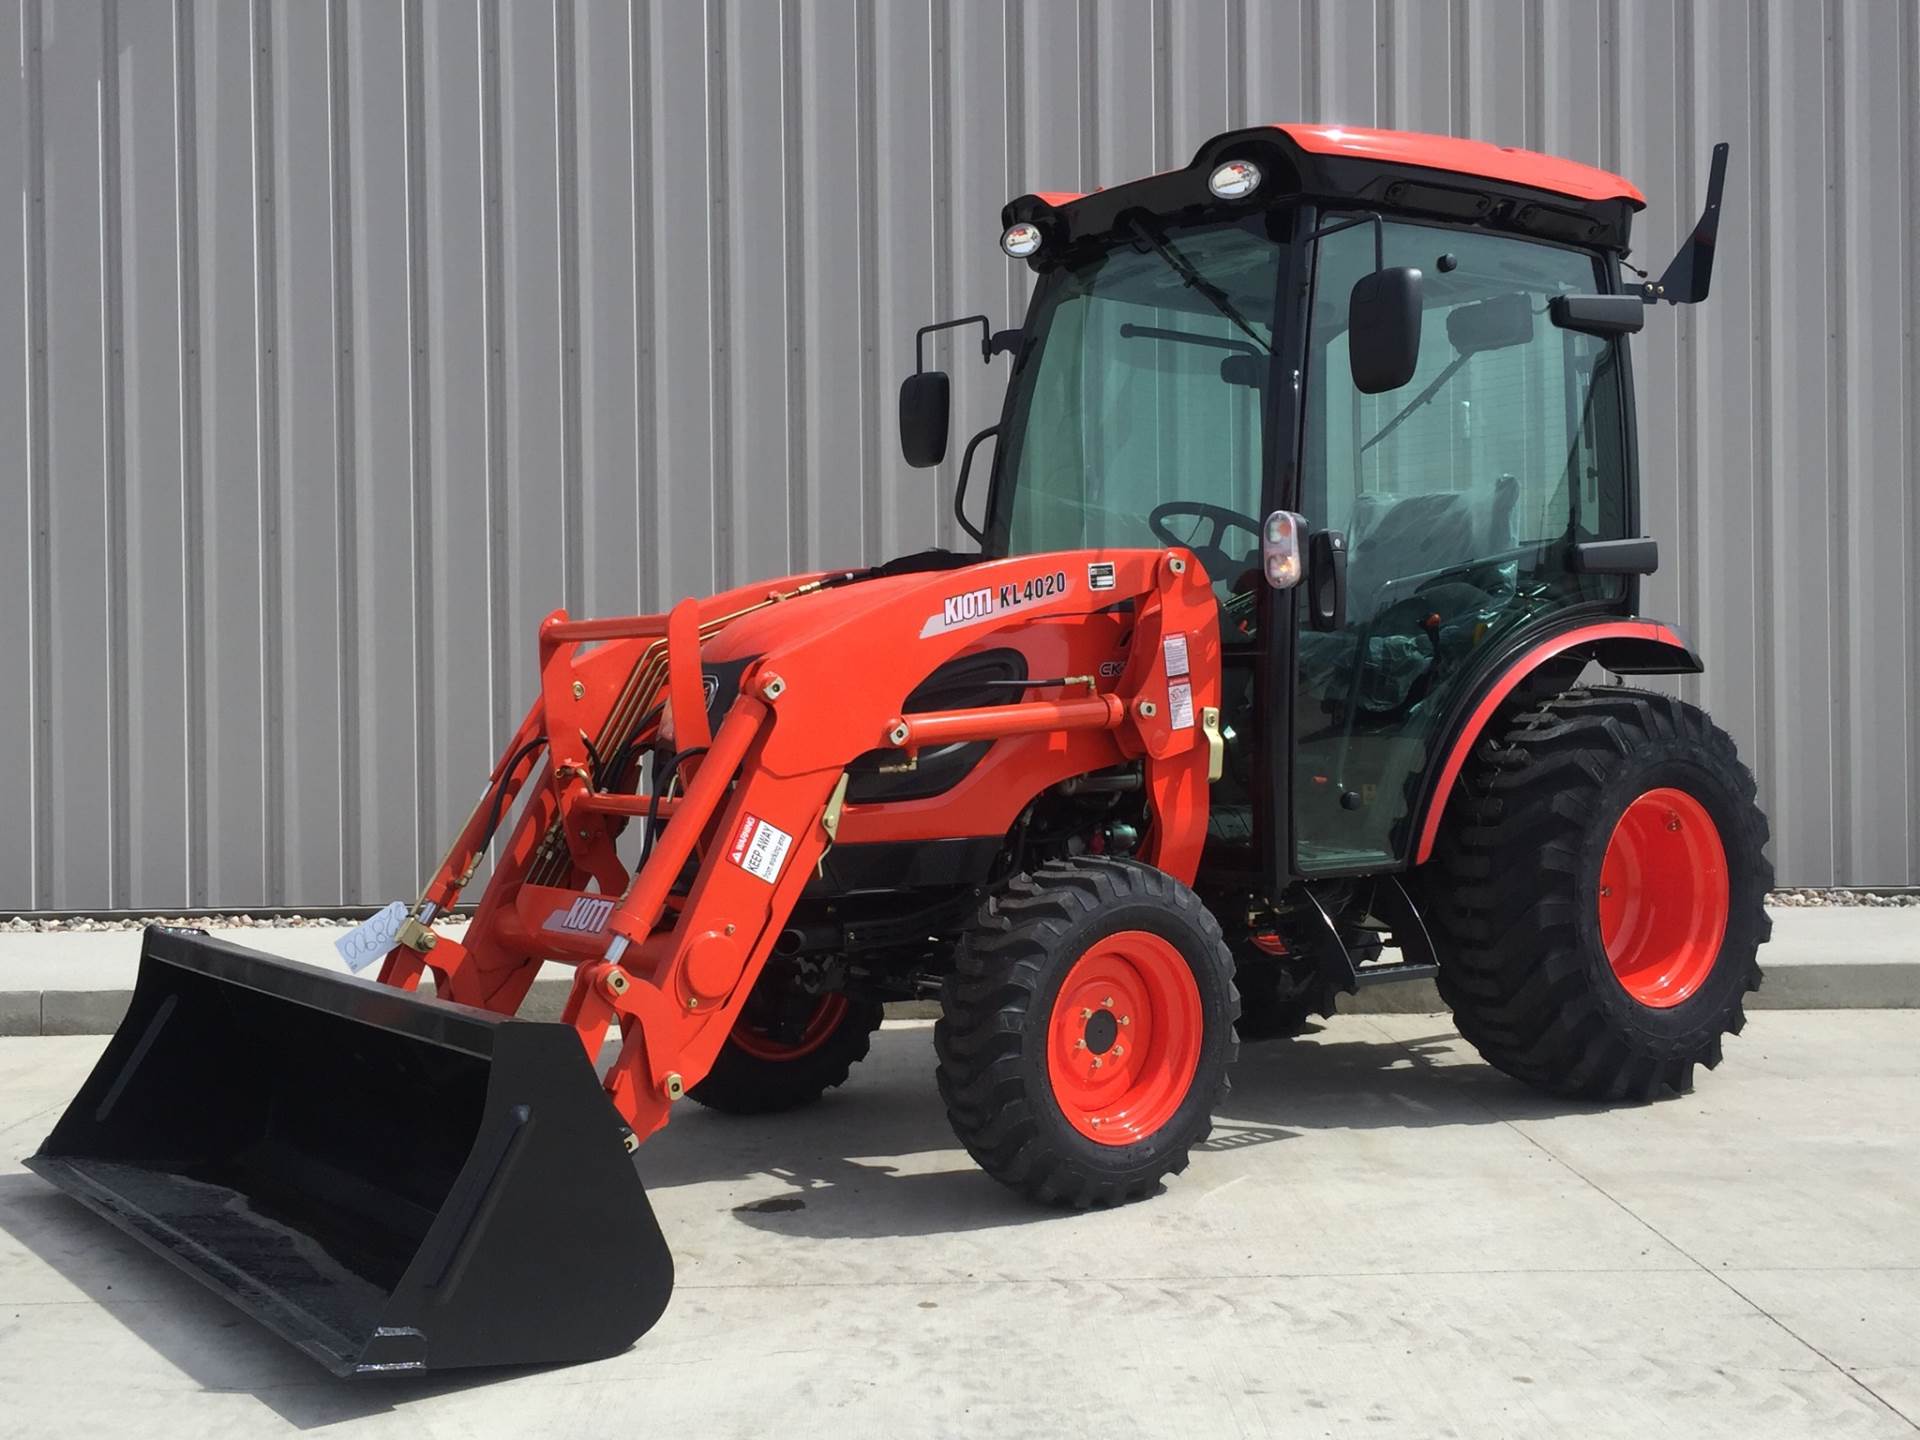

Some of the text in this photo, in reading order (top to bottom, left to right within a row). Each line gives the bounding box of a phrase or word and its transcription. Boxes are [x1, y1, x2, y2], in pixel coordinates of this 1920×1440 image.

[944, 587, 993, 626] KIOTI
[1000, 572, 1066, 608] KL4020
[747, 825, 774, 873] KEEP AWAY
[561, 896, 616, 934] KIOTI
